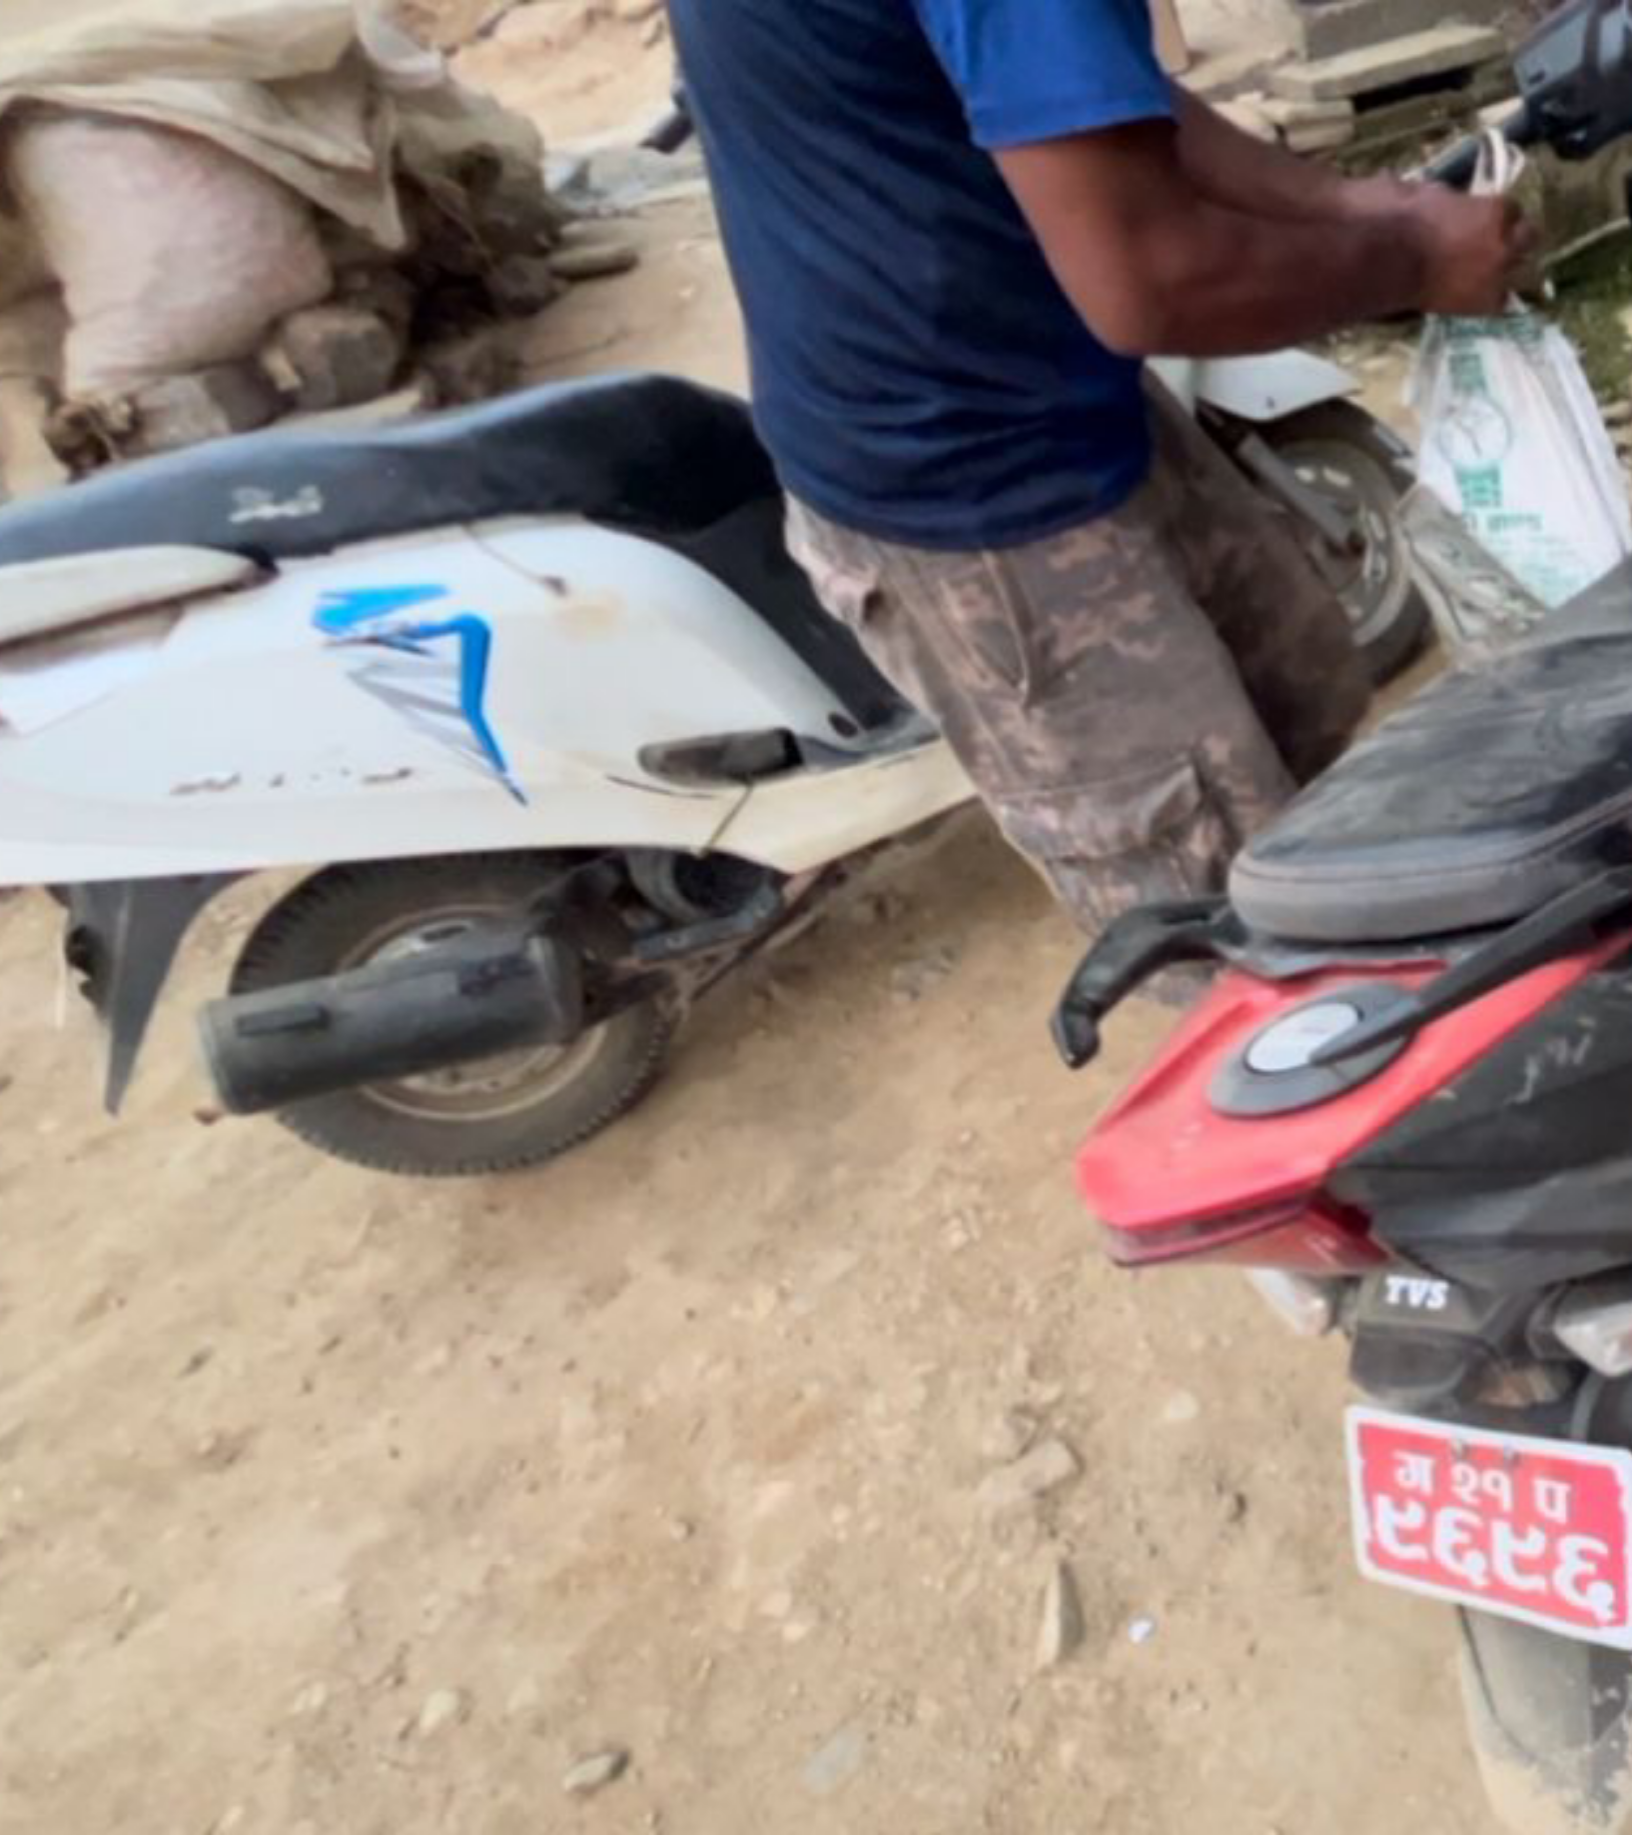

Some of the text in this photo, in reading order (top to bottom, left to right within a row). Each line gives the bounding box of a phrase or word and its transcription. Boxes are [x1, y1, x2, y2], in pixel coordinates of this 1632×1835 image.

[1385, 1275, 1449, 1310] TVS
[1450, 1460, 1513, 1513] २१
[1532, 1477, 1571, 1524] प
